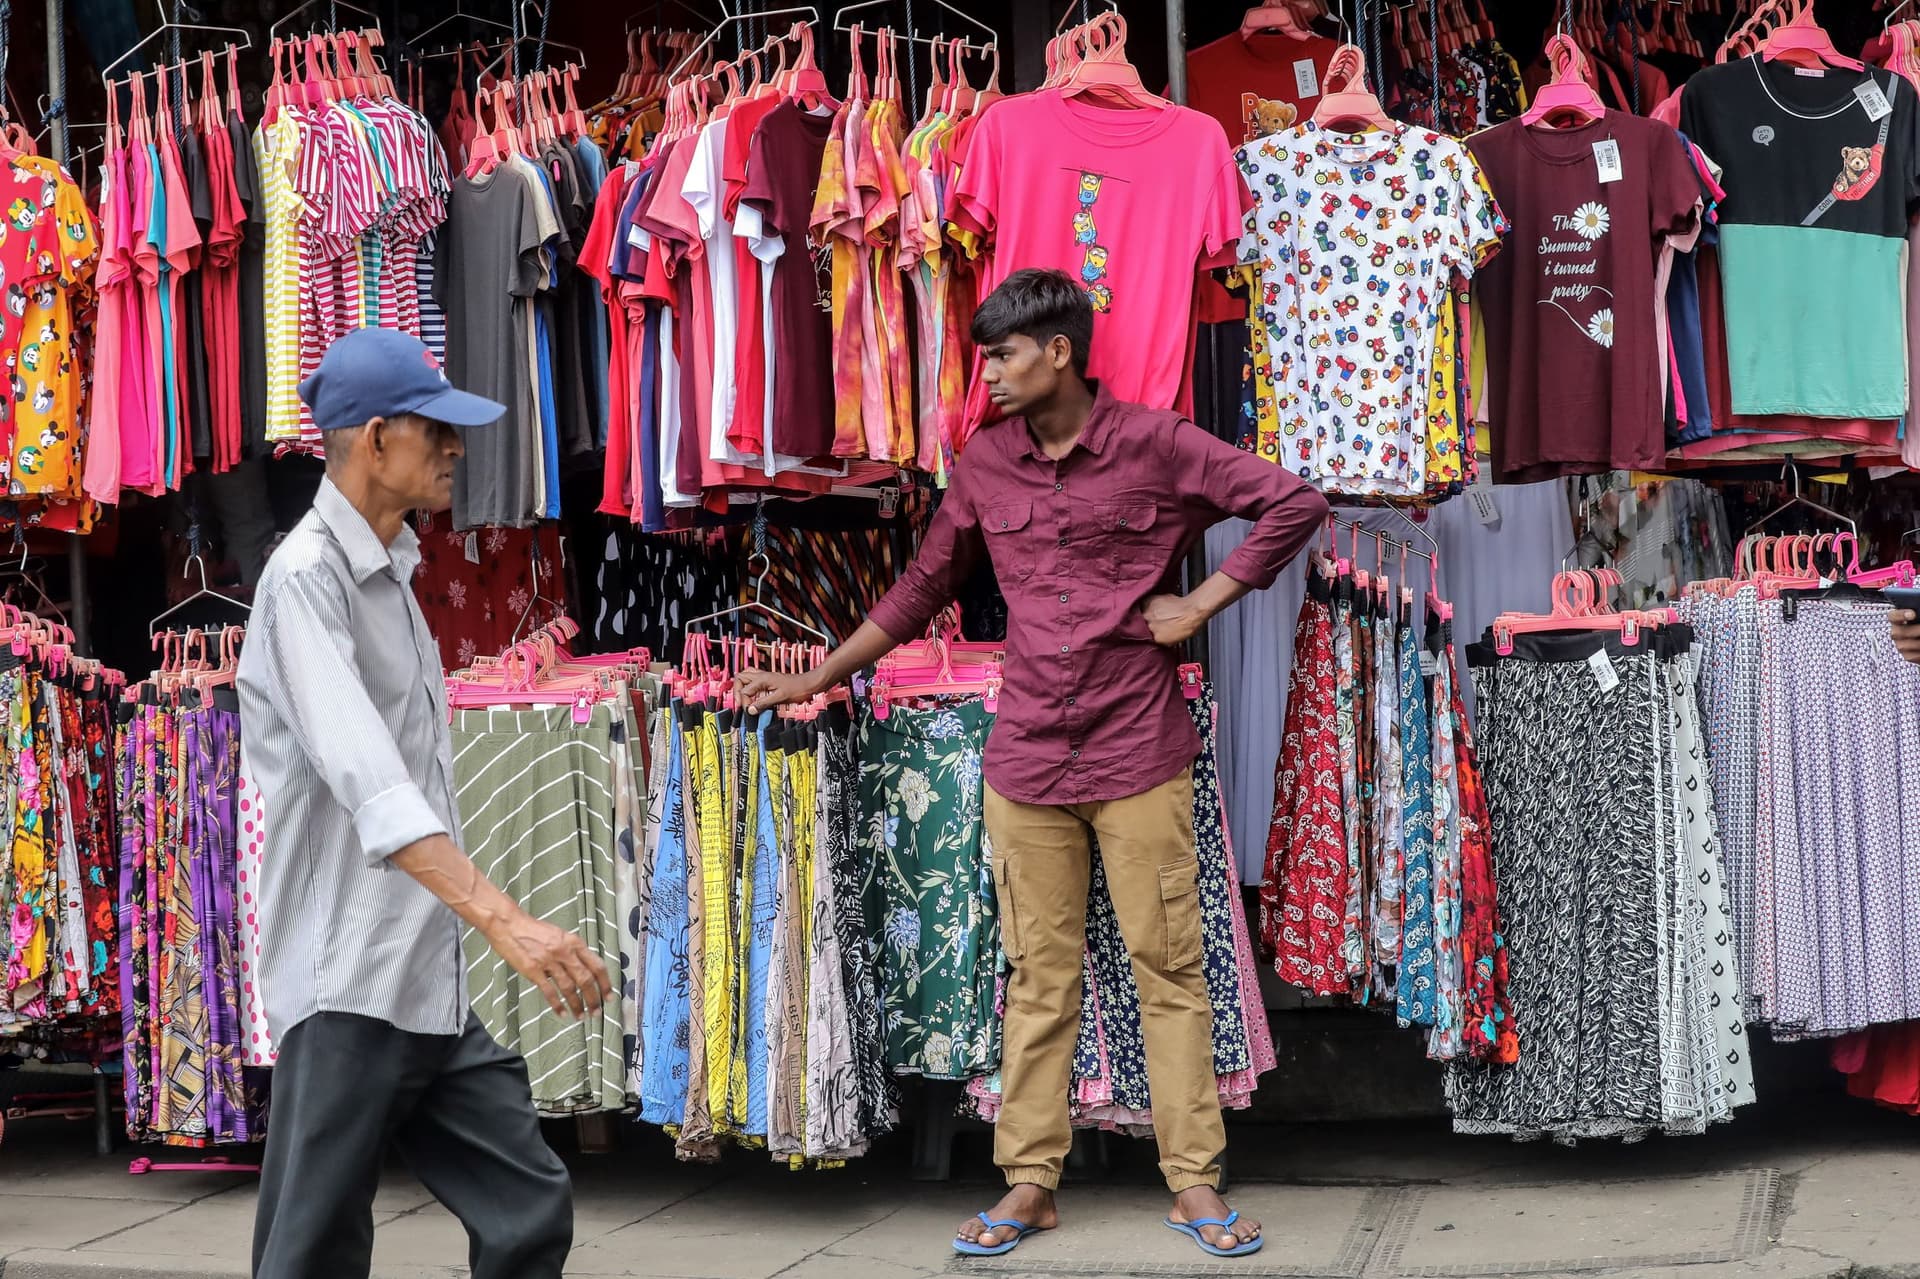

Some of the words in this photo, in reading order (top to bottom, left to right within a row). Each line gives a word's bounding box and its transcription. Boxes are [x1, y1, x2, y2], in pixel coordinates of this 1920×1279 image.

[1759, 133, 1768, 141] Go
[1879, 122, 1888, 144] STYLE
[1818, 198, 1832, 212] COOL
[1552, 214, 1577, 232] The
[1538, 236, 1592, 255] Summer
[1553, 259, 1597, 276] turned
[1551, 283, 1593, 302] pretty
[705, 1010, 728, 1040] BEST
